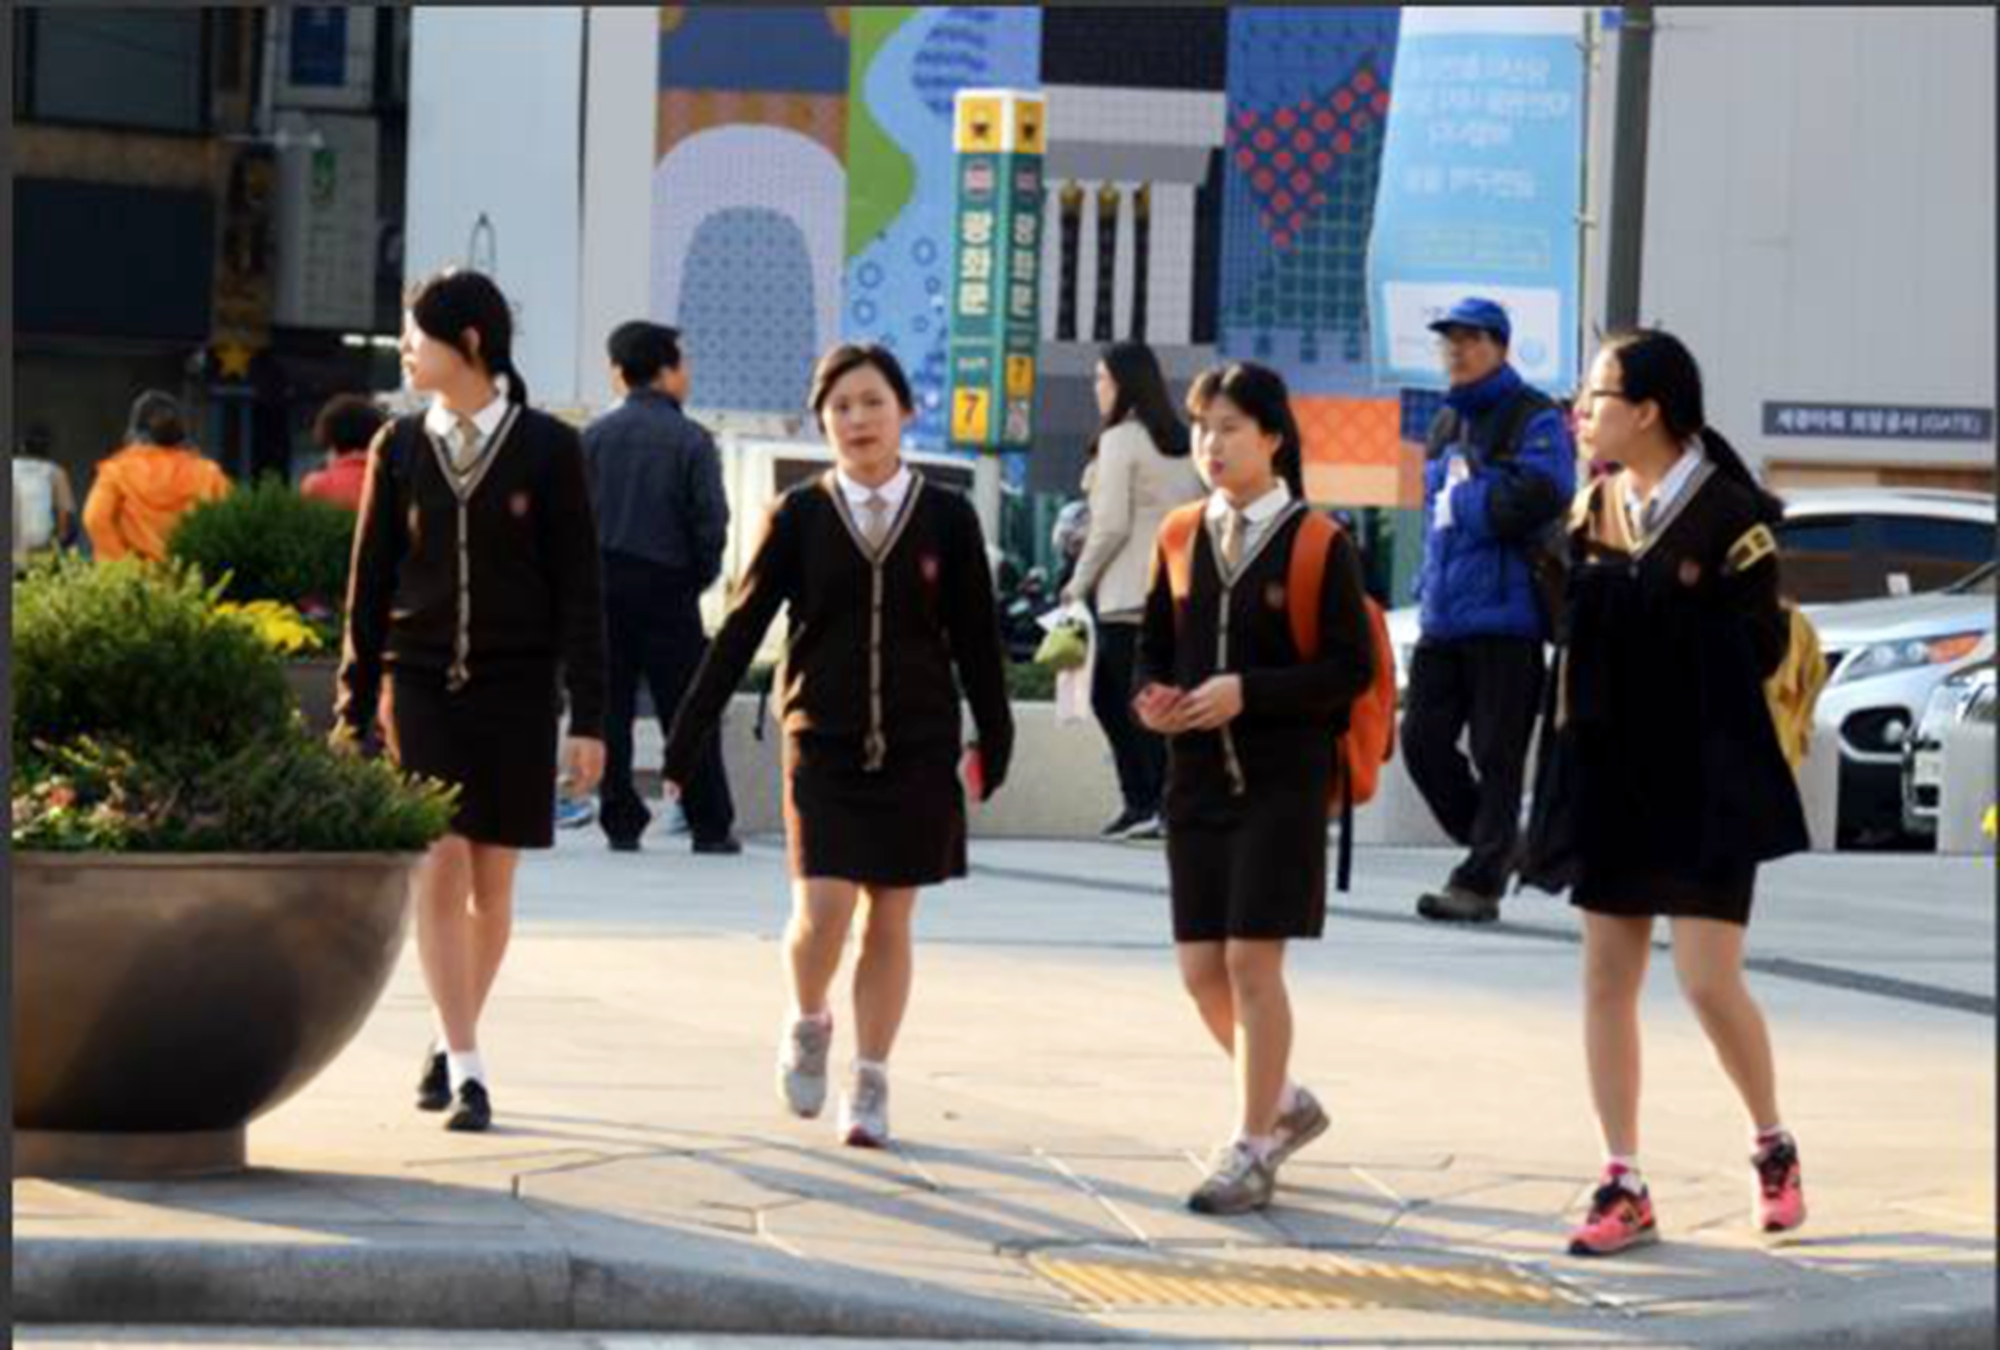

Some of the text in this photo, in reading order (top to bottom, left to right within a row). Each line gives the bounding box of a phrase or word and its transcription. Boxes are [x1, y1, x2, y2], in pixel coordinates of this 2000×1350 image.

[960, 210, 993, 315] 광화문
[1011, 212, 1036, 317] 광화문
[963, 394, 980, 425] 7
